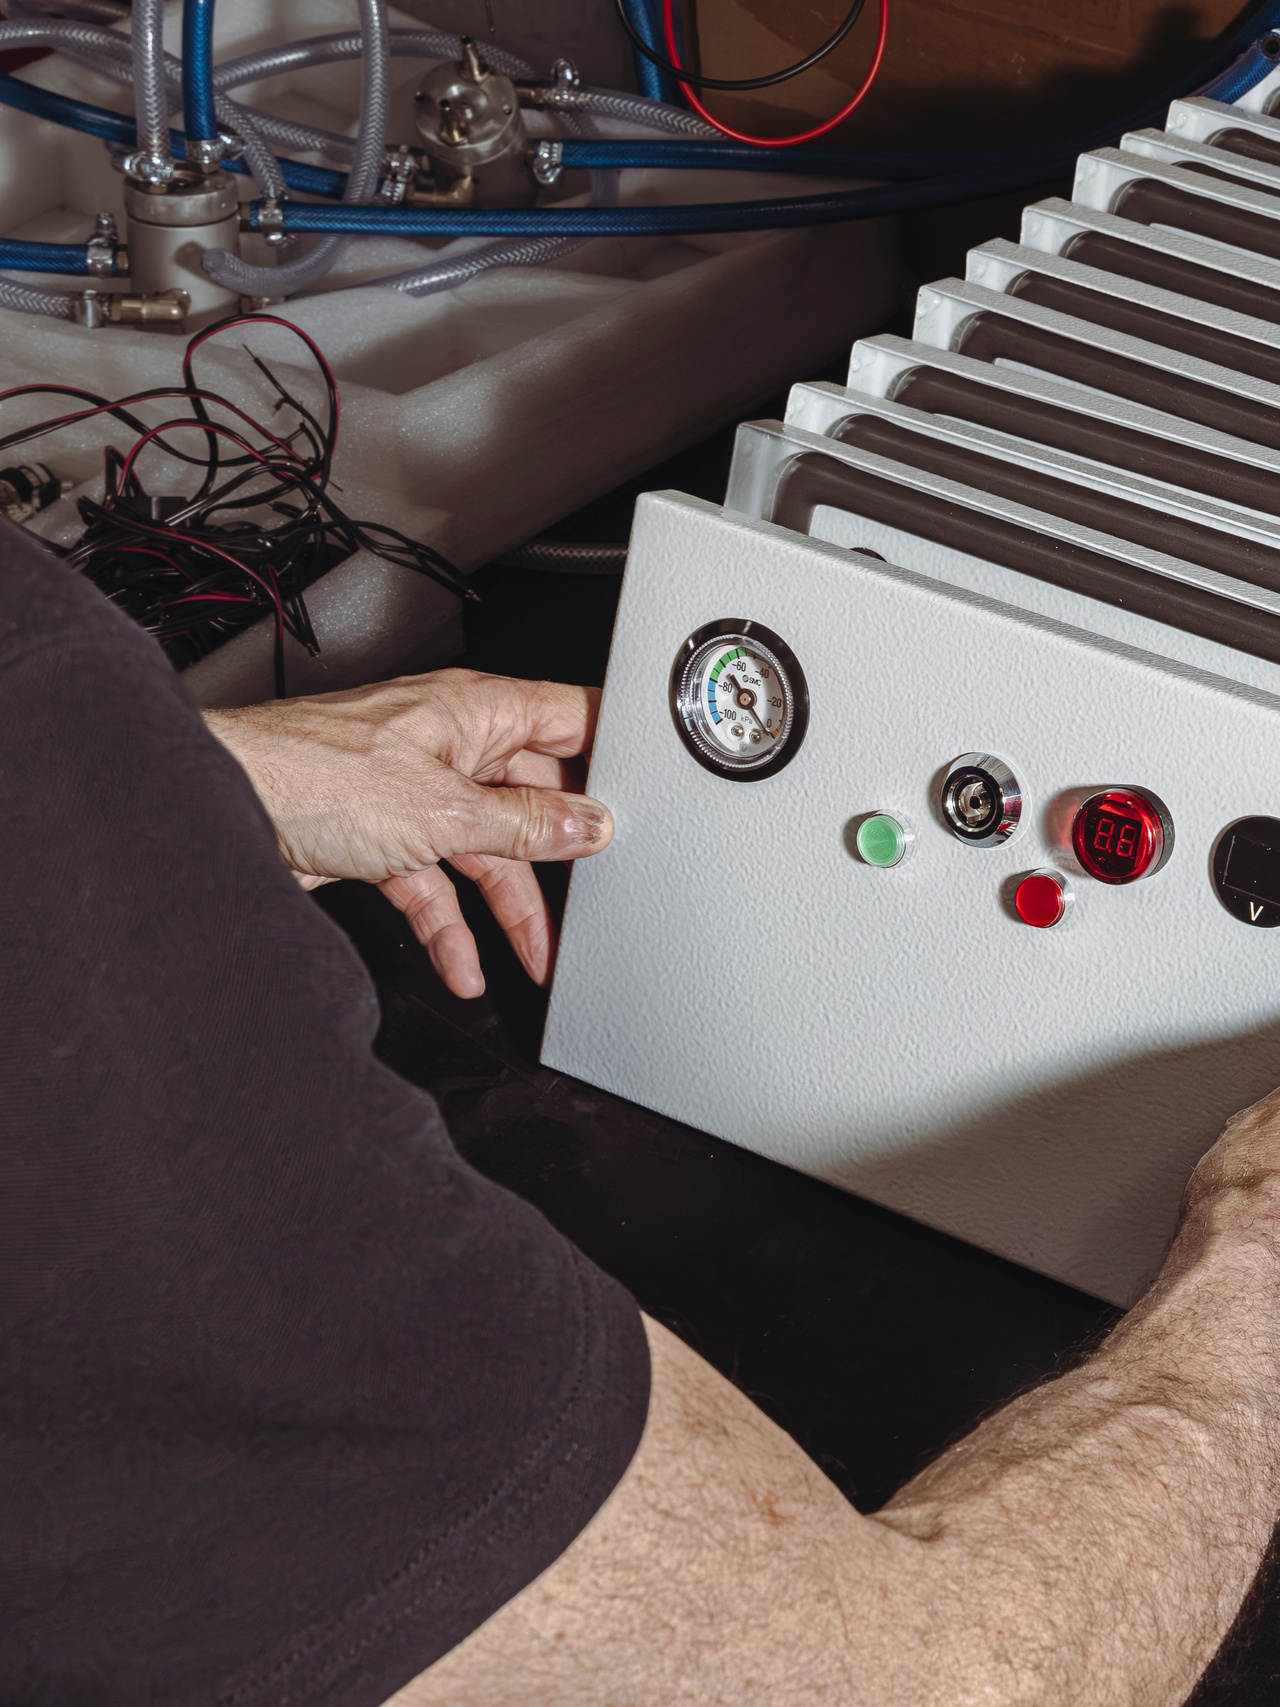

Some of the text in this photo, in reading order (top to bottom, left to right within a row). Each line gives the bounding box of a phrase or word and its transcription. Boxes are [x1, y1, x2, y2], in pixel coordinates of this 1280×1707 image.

[732, 660, 746, 672] -60
[755, 668, 770, 679] -40
[748, 675, 762, 687] SMC
[718, 682, 733, 693] -80
[767, 696, 782, 708] -20
[719, 708, 737, 721] -100
[740, 715, 753, 724] kPa
[766, 718, 772, 728] 0
[1249, 901, 1264, 921] V
